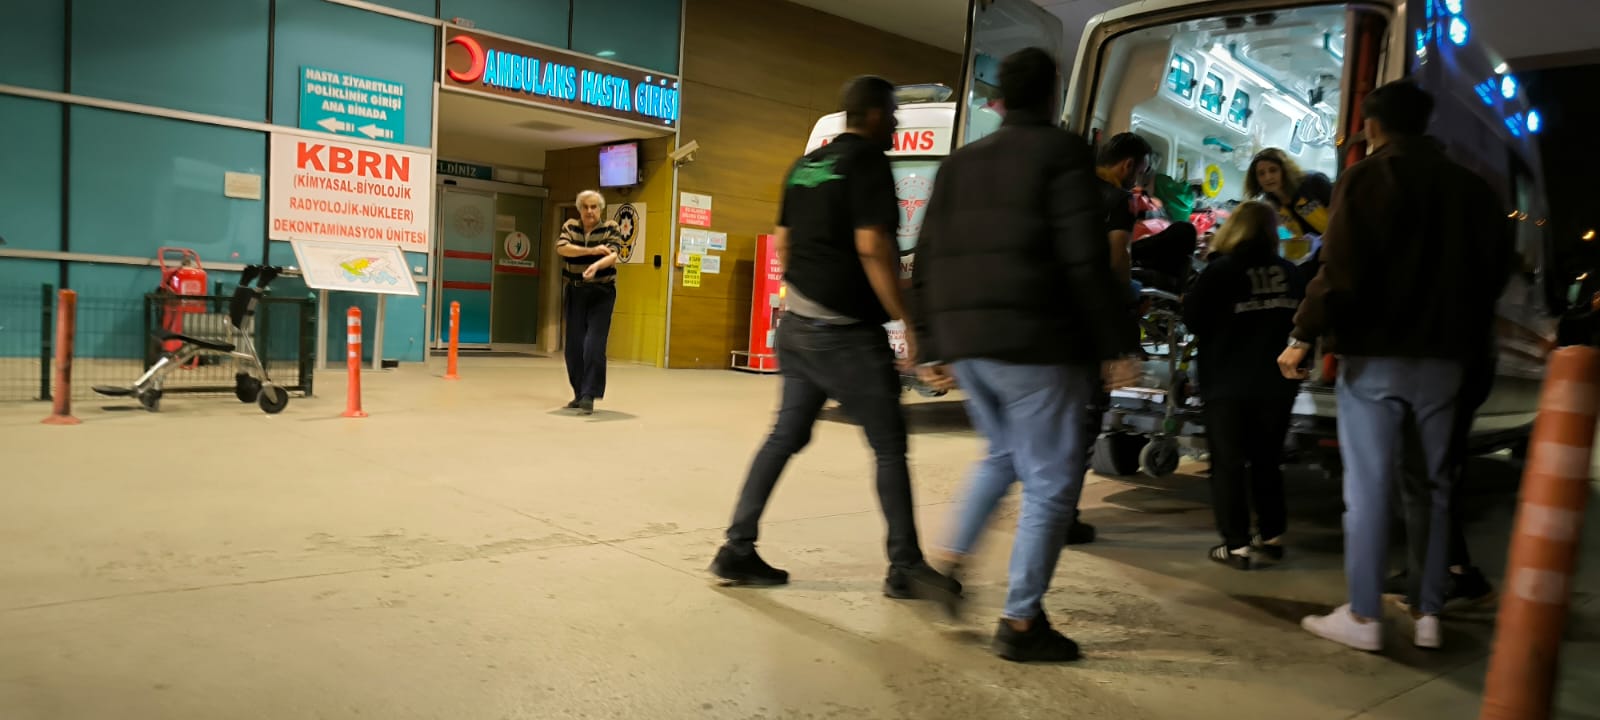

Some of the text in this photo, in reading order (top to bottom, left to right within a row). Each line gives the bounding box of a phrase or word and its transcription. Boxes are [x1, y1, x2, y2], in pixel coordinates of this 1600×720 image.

[305, 68, 404, 96] HASTA ZİYARETLERİ
[483, 48, 680, 125] AMBULANS HASTA GİRİŞİ
[307, 83, 402, 111] POLİKLİNİK GİRİŞİ
[321, 99, 388, 121] ANA BİNADA
[296, 142, 411, 182] KBRN
[437, 162, 479, 178] LDİNİZ
[293, 174, 412, 199] (KİMYASAL-BİYOLOJİK
[289, 196, 415, 225] RADYOLOJİK-NÜKLEER)
[386, 225, 427, 245] ÜNİTESİ
